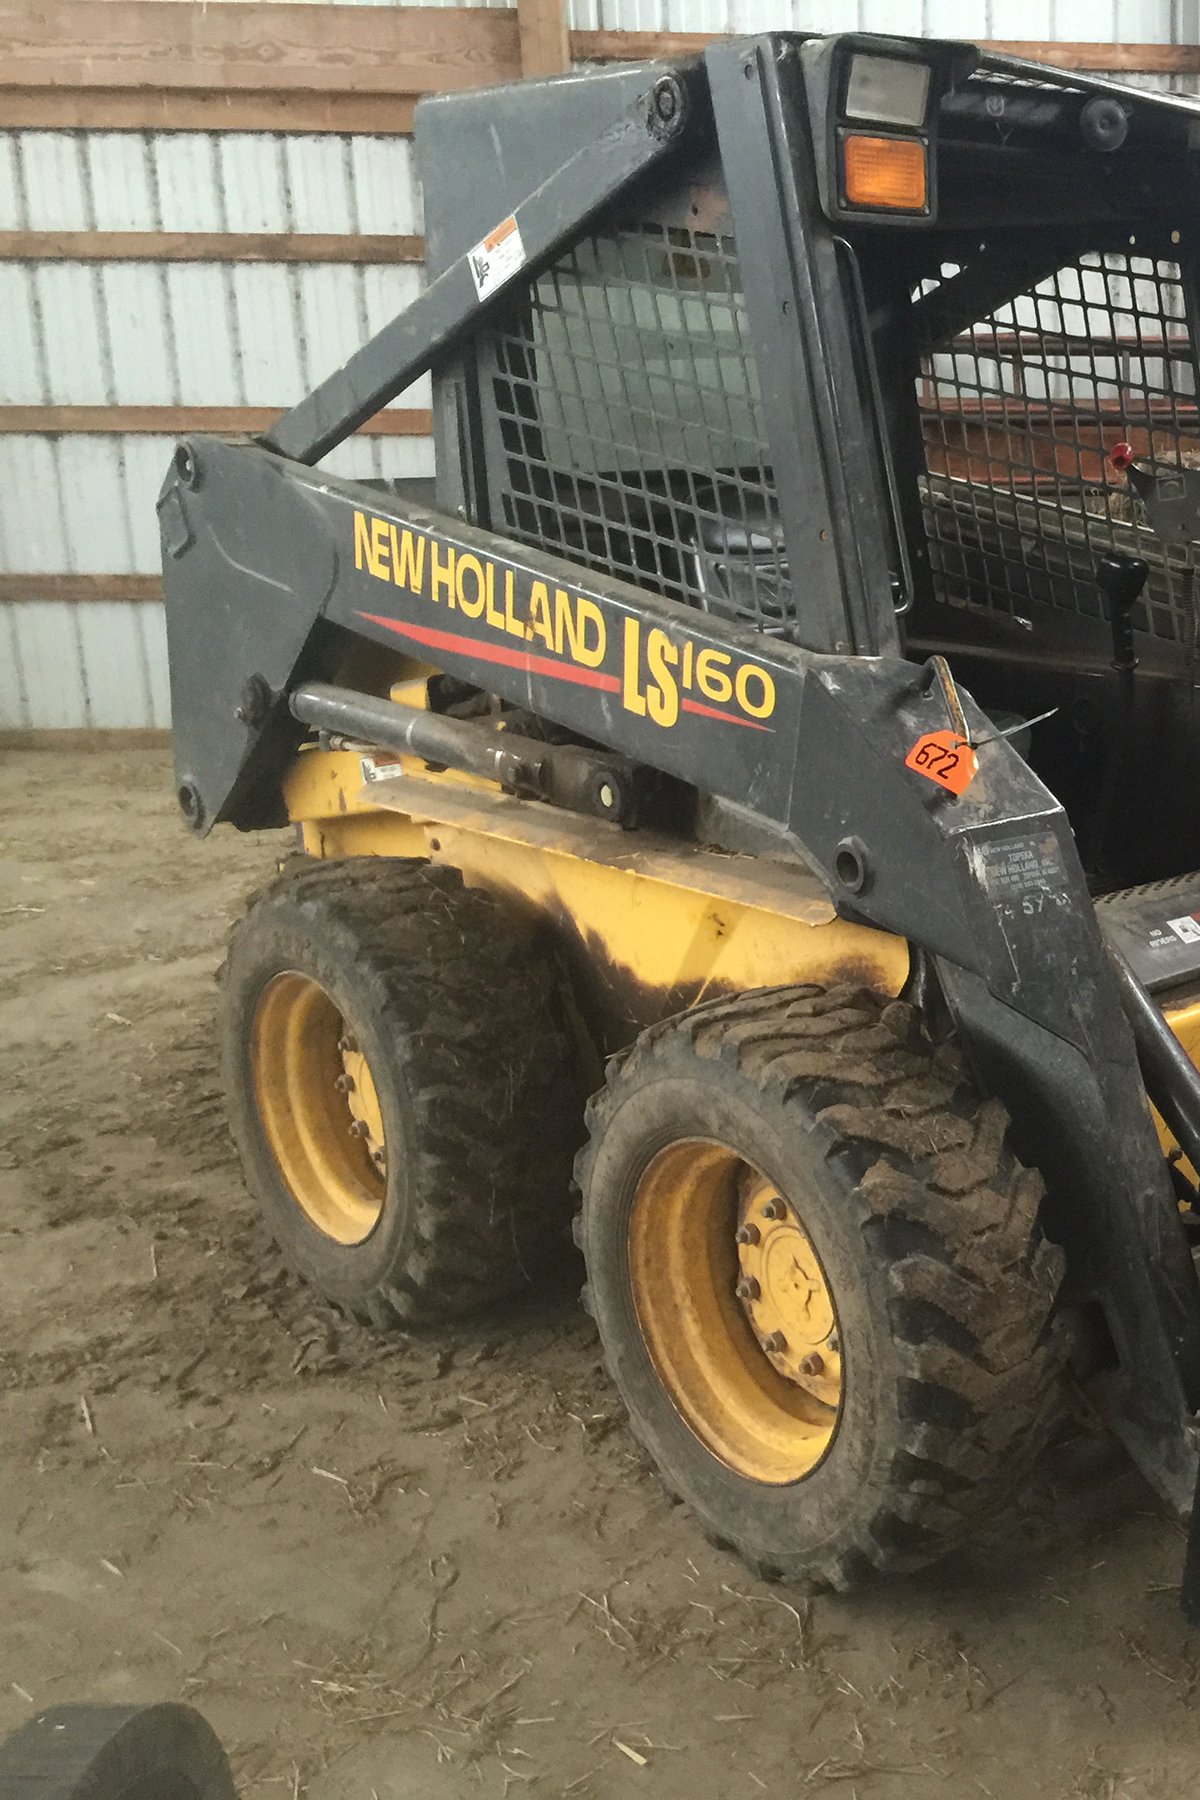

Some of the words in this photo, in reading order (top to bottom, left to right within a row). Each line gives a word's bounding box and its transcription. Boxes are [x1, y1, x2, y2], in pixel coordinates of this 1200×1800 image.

[353, 510, 425, 595] NEW
[431, 542, 606, 668] HOLLAND
[915, 742, 960, 779] 672
[1007, 850, 1034, 862] TOPEKA
